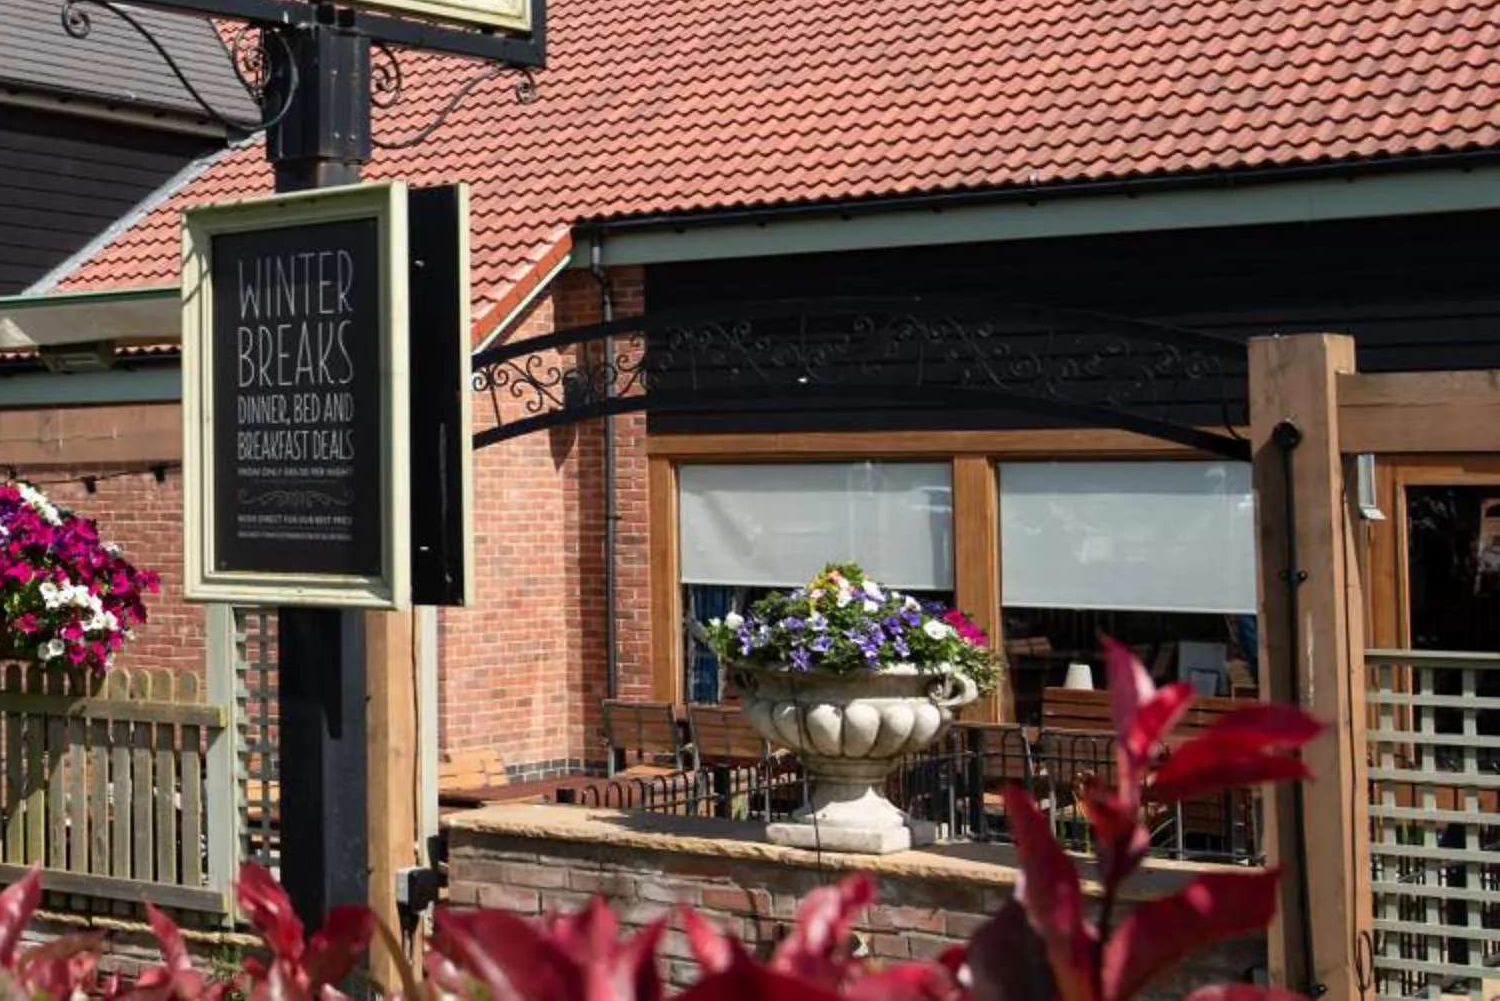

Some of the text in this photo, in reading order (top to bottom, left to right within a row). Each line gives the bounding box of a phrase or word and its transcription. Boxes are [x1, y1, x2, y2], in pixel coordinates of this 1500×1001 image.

[237, 249, 354, 319] WINTER
[237, 320, 354, 388] BREAKS
[237, 392, 354, 426] DINNER, BED AND
[237, 428, 355, 461] BREAKFAST DEALS
